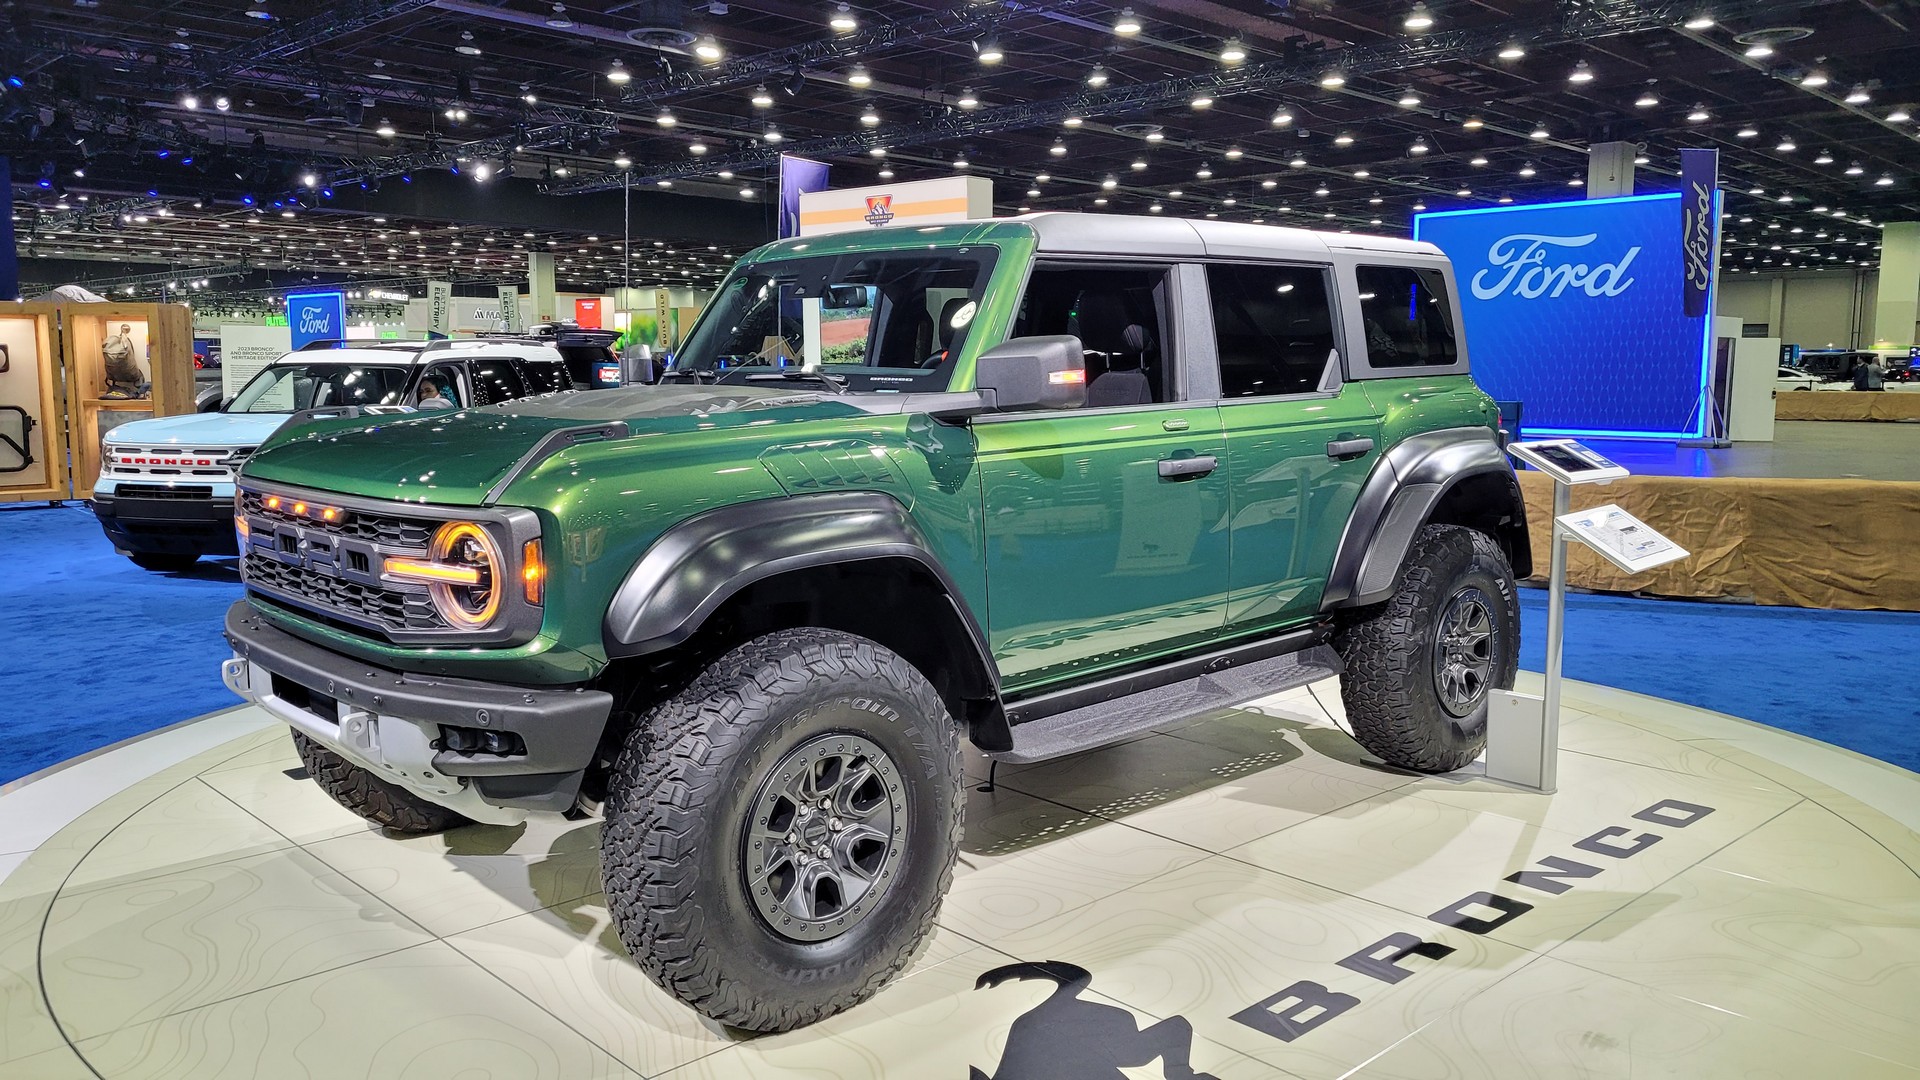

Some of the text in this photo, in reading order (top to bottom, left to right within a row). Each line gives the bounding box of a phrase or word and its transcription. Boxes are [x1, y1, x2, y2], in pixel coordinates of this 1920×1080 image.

[1683, 180, 1711, 292] Ford
[1470, 232, 1642, 301] Ford
[381, 291, 409, 301] CHEVROLET
[433, 287, 441, 330] ELECTRIFY
[440, 305, 446, 316] TO
[299, 306, 330, 334] Ford
[509, 309, 515, 319] TO
[121, 457, 211, 466] BRONCO
[248, 515, 384, 588] FORD
[1228, 799, 1717, 1044] BRONCO
